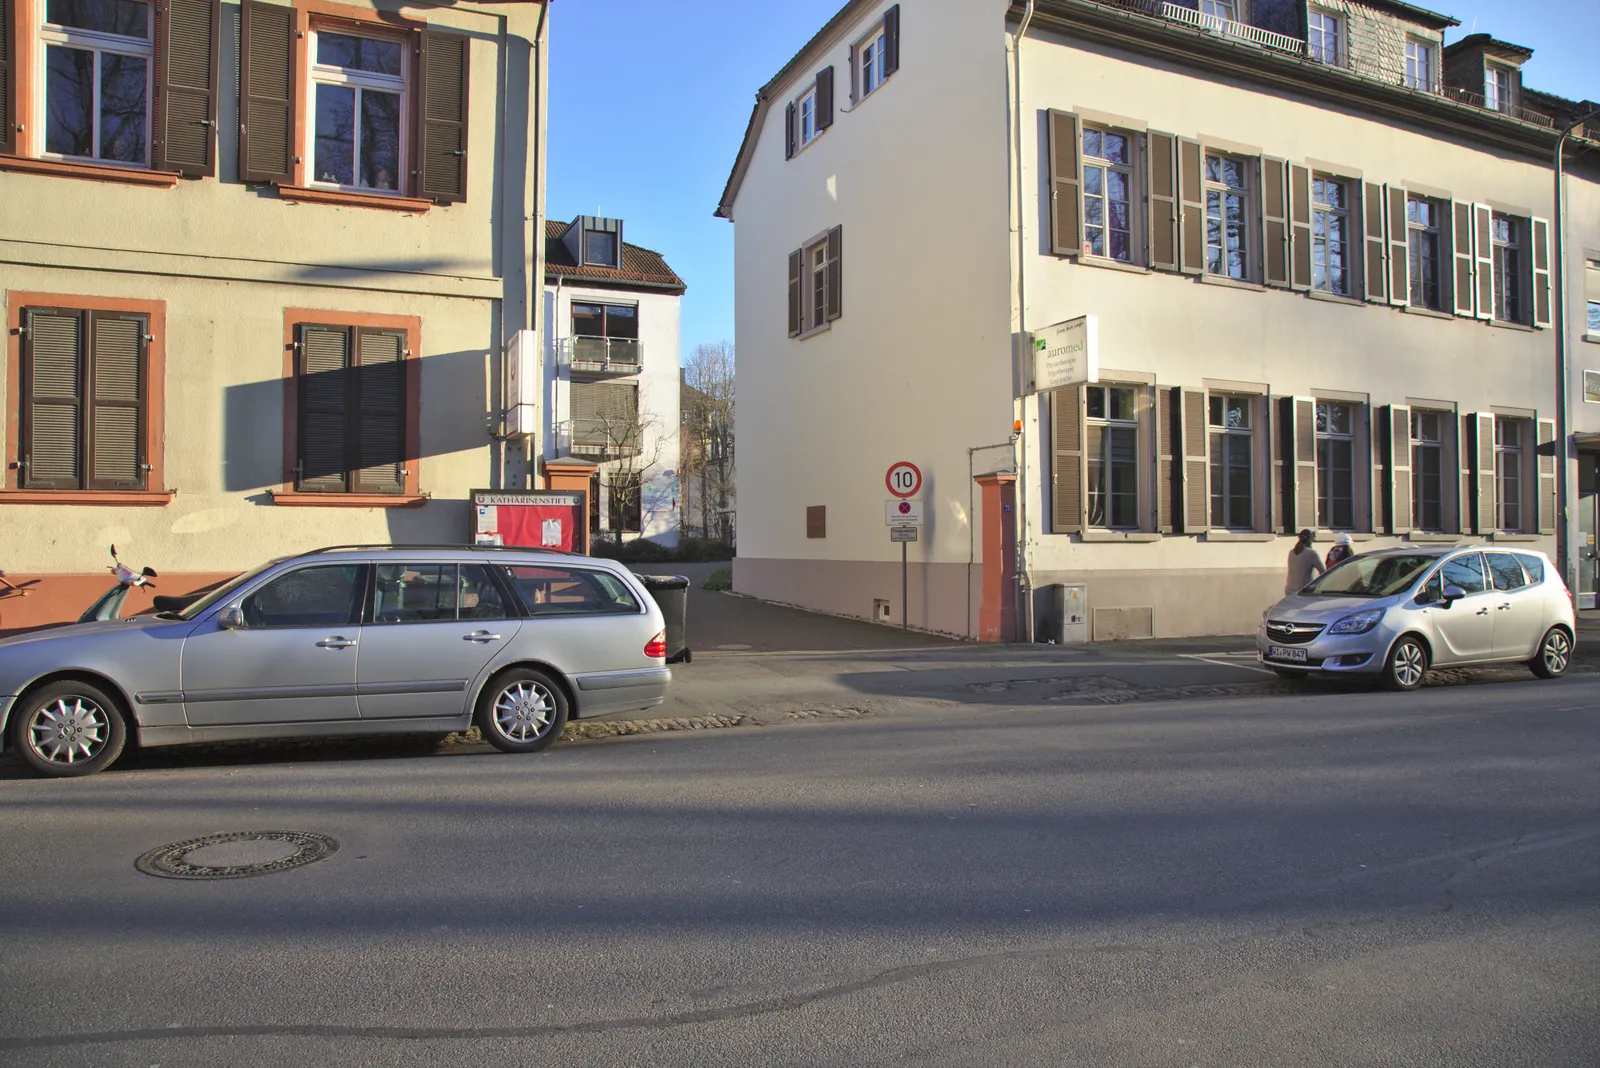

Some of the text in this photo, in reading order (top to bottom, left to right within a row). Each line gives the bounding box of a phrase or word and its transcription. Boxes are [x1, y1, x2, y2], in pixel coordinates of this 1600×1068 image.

[1047, 339, 1083, 358] auromed
[894, 471, 912, 488] 10
[490, 496, 568, 504] KATHARINENSTIFT
[1292, 650, 1305, 659] 847
